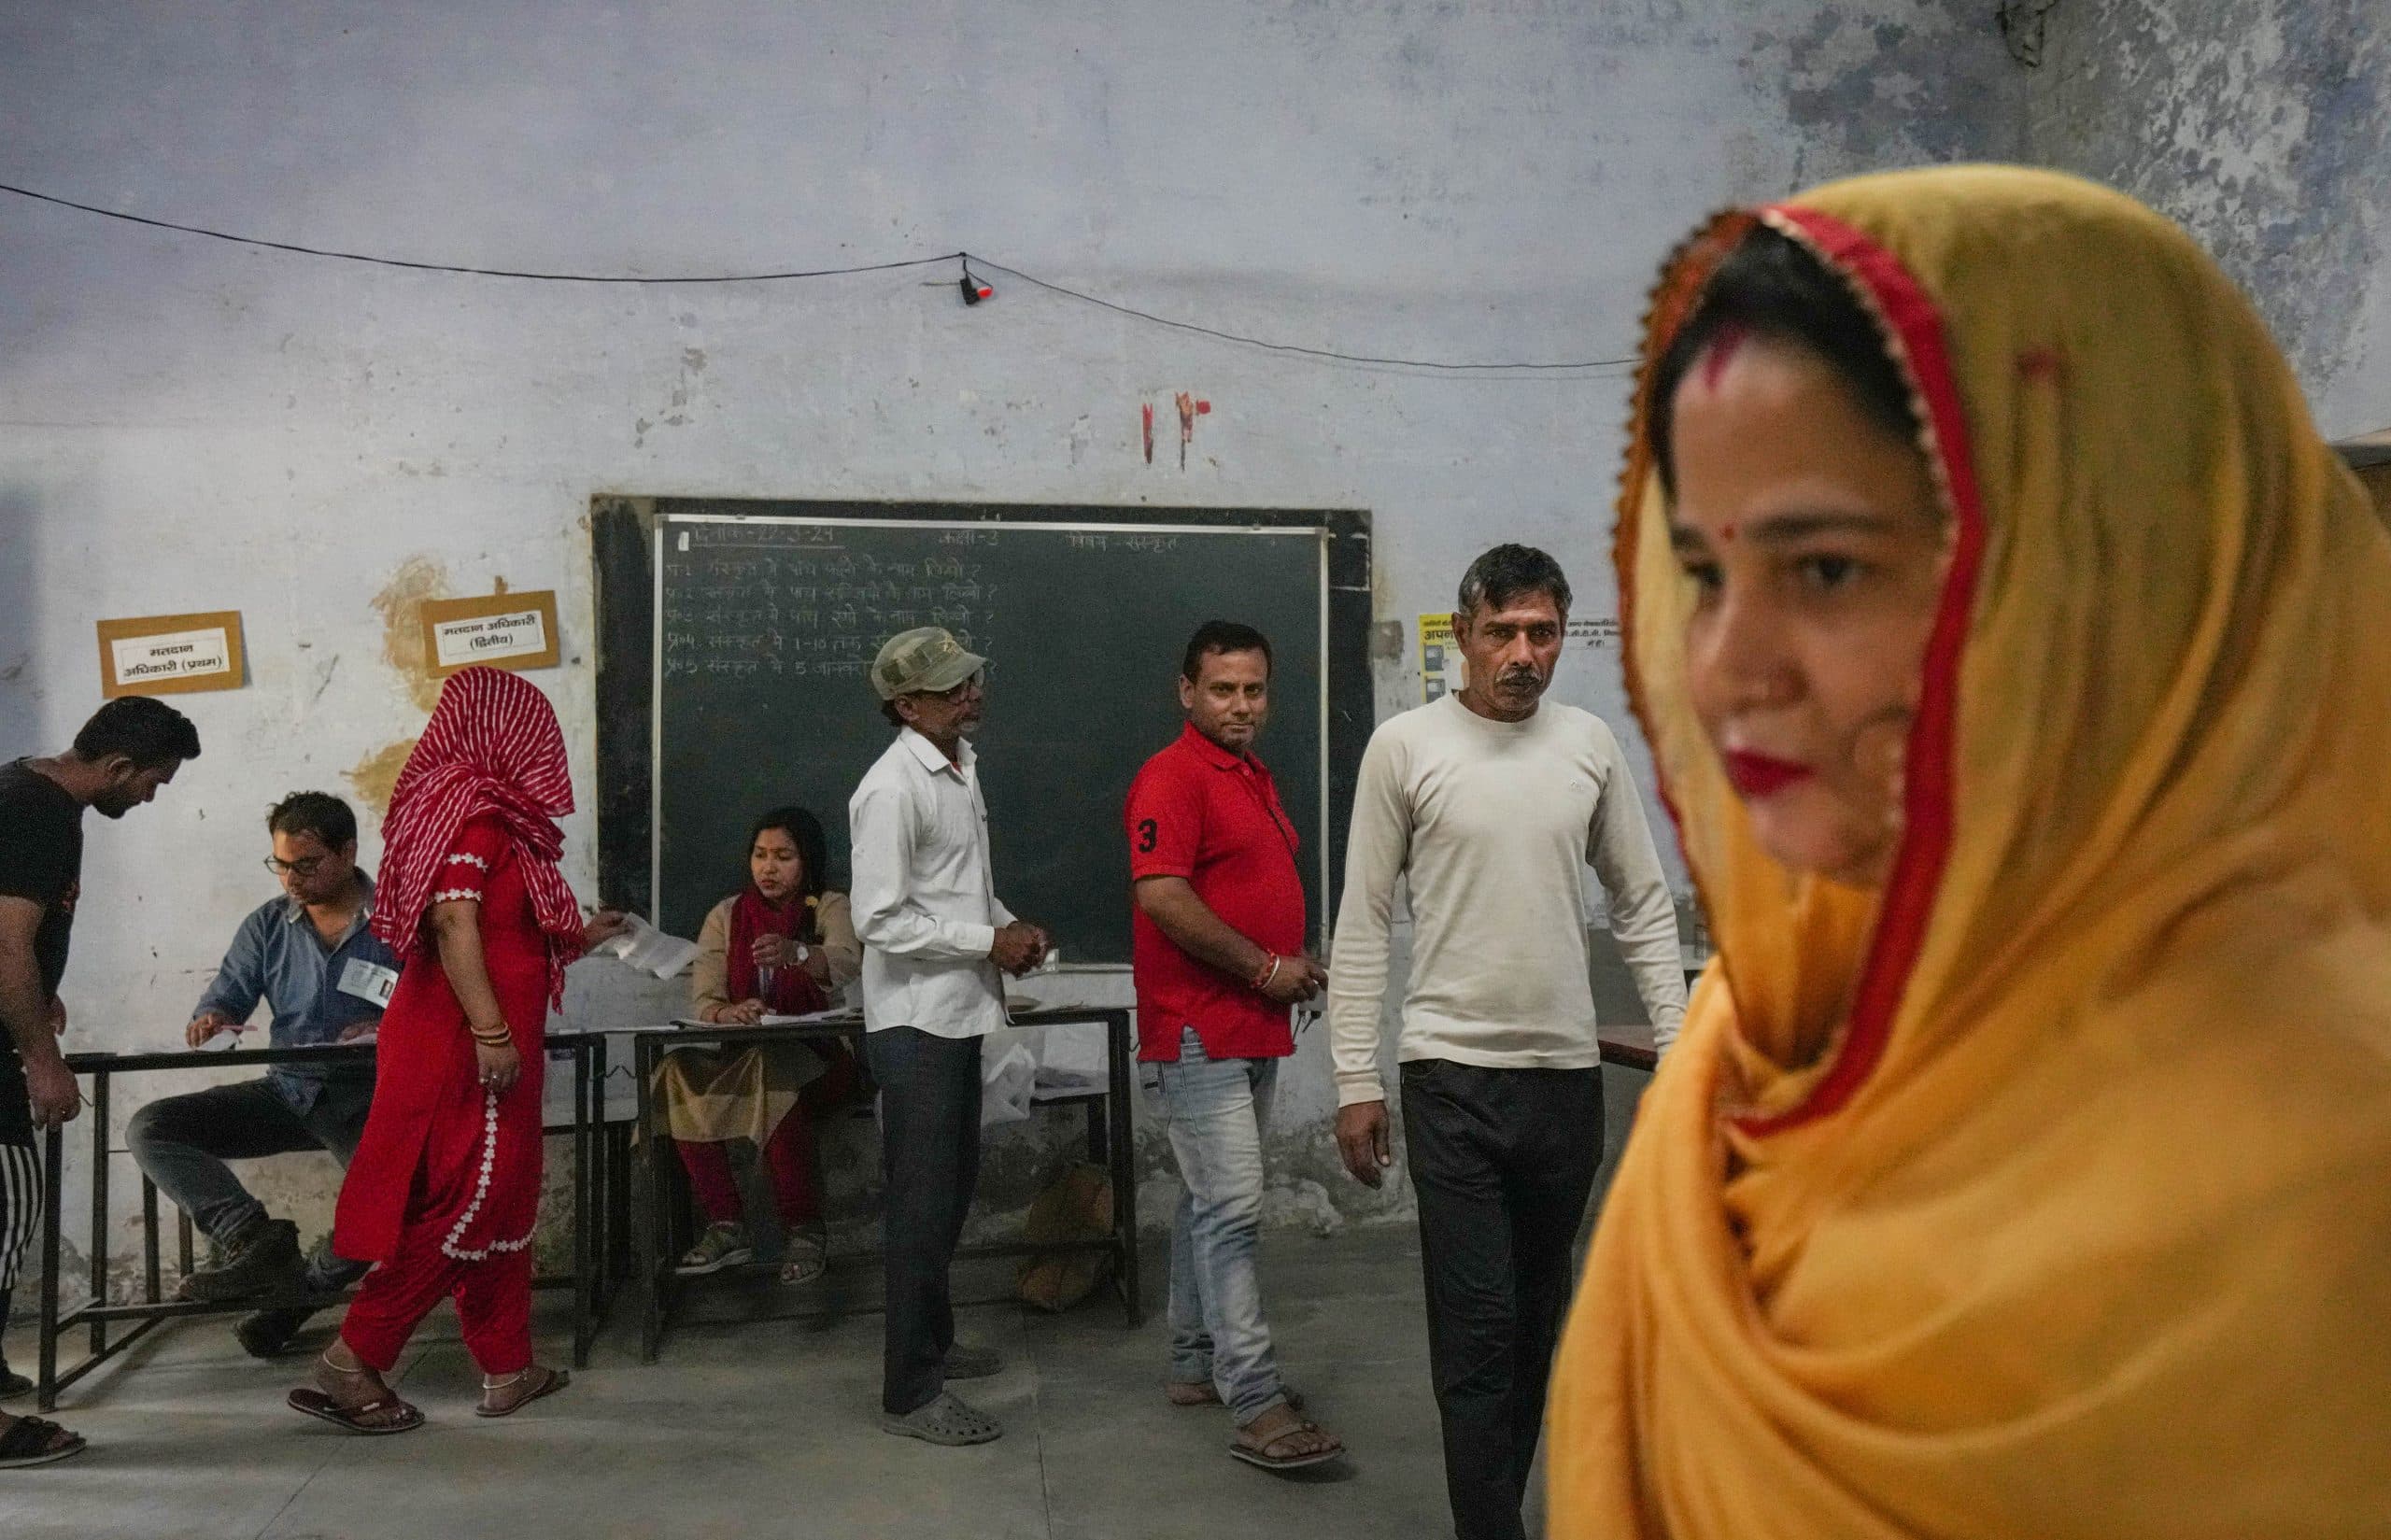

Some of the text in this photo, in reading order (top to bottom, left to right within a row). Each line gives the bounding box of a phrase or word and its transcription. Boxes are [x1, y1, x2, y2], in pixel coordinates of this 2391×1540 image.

[444, 614, 536, 636] मतदान अधिकारी
[149, 644, 193, 657] मतदान
[470, 633, 514, 651] (द्वितीय)
[123, 655, 223, 677] अधिकारी (प्रथम)
[1138, 818, 1157, 853] 3
